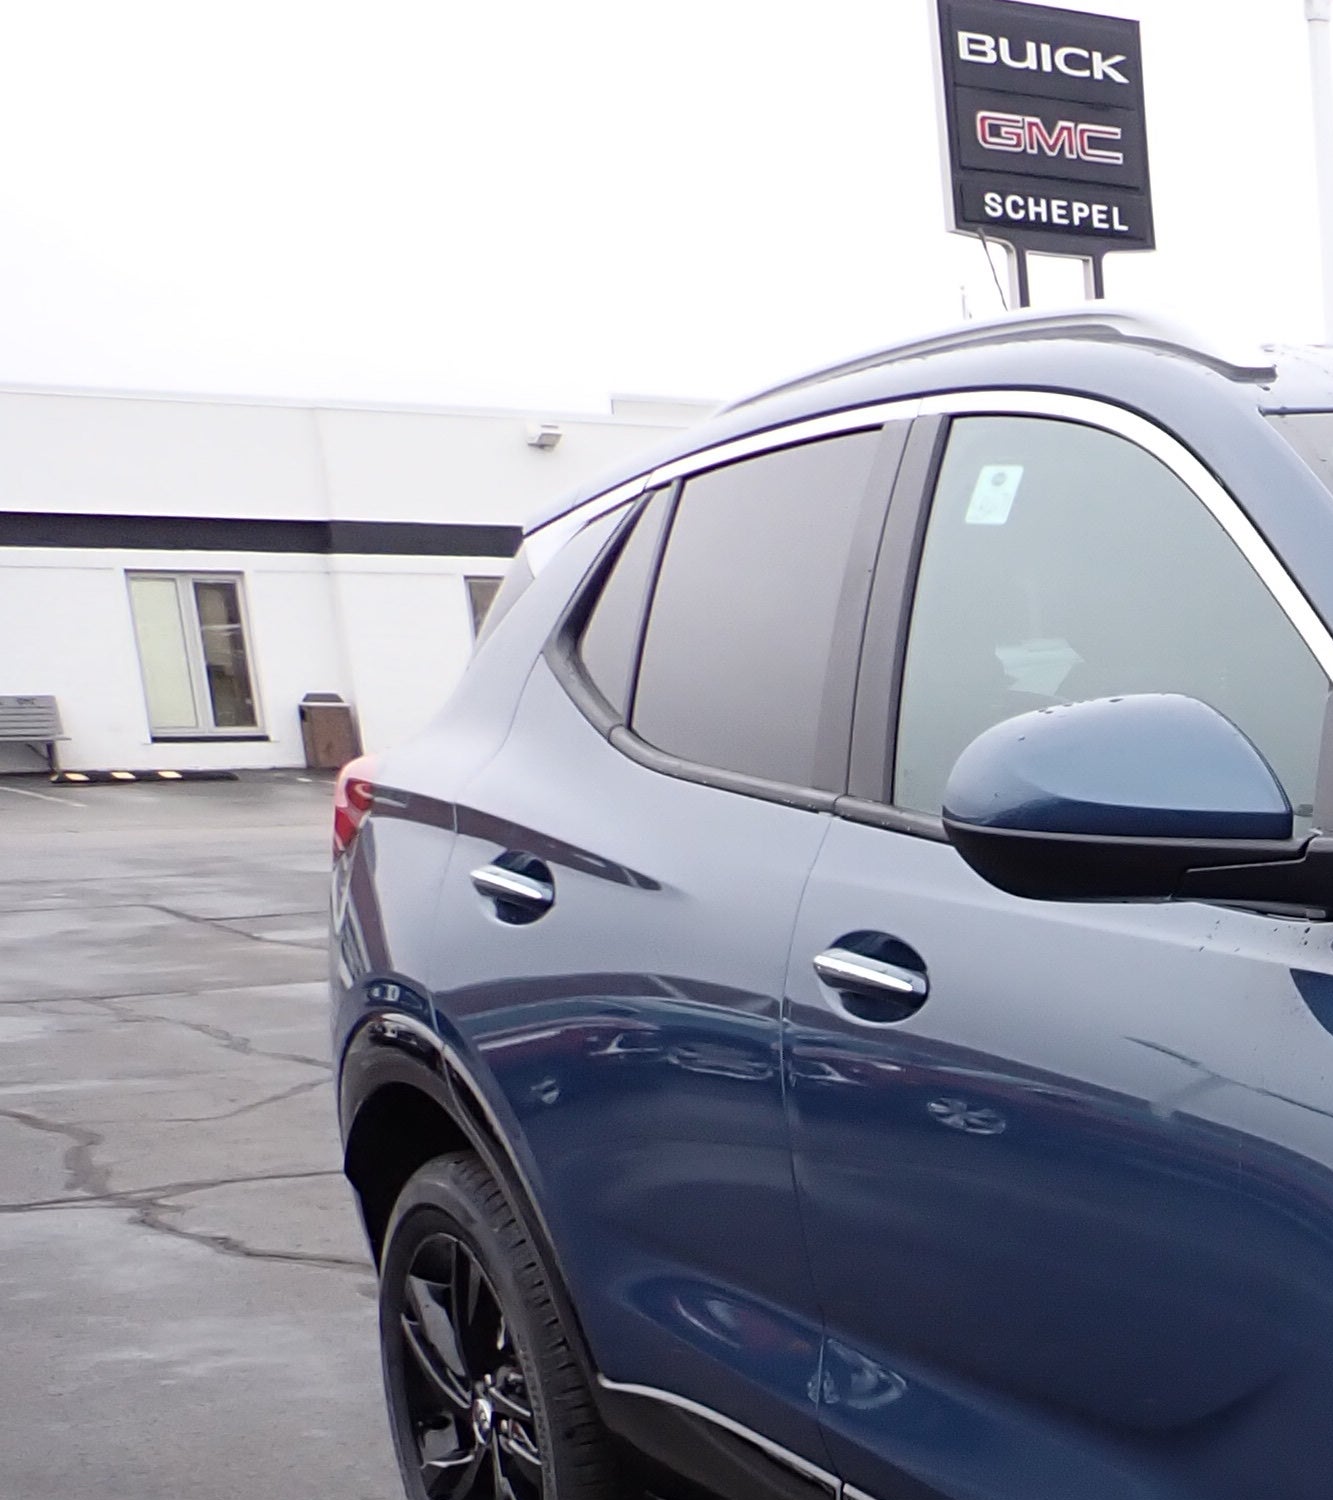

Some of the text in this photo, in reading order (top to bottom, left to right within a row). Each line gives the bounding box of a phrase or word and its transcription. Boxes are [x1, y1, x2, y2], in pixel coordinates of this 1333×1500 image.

[957, 30, 1129, 83] BUICK
[976, 110, 1123, 165] GMC
[983, 192, 1129, 231] SCHEPEL
